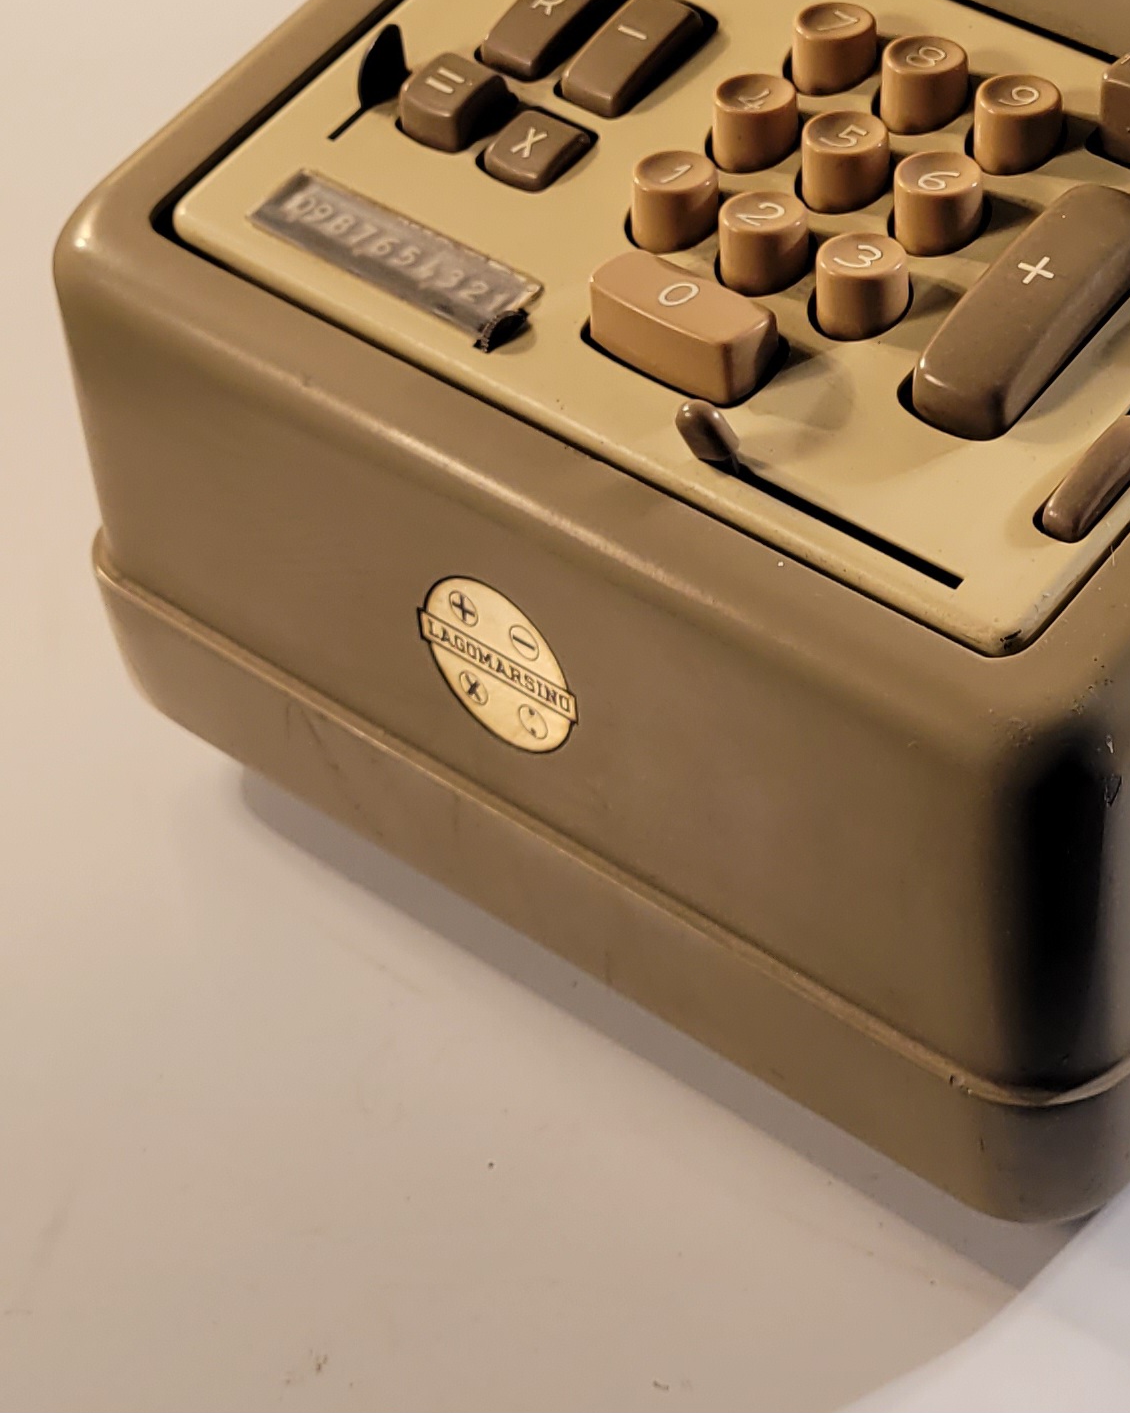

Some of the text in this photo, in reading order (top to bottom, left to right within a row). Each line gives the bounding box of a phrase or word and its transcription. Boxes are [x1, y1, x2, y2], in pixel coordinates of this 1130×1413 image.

[817, 11, 859, 32] 7
[905, 46, 948, 69] 8
[739, 89, 771, 111] 4
[998, 87, 1040, 108] 9
[819, 124, 868, 148] 5
[660, 164, 692, 184] 1
[917, 170, 961, 191] 6
[736, 202, 785, 226] 2
[833, 244, 883, 269] 3
[657, 282, 699, 308] 0
[427, 618, 571, 713] LAGOMARSINO
